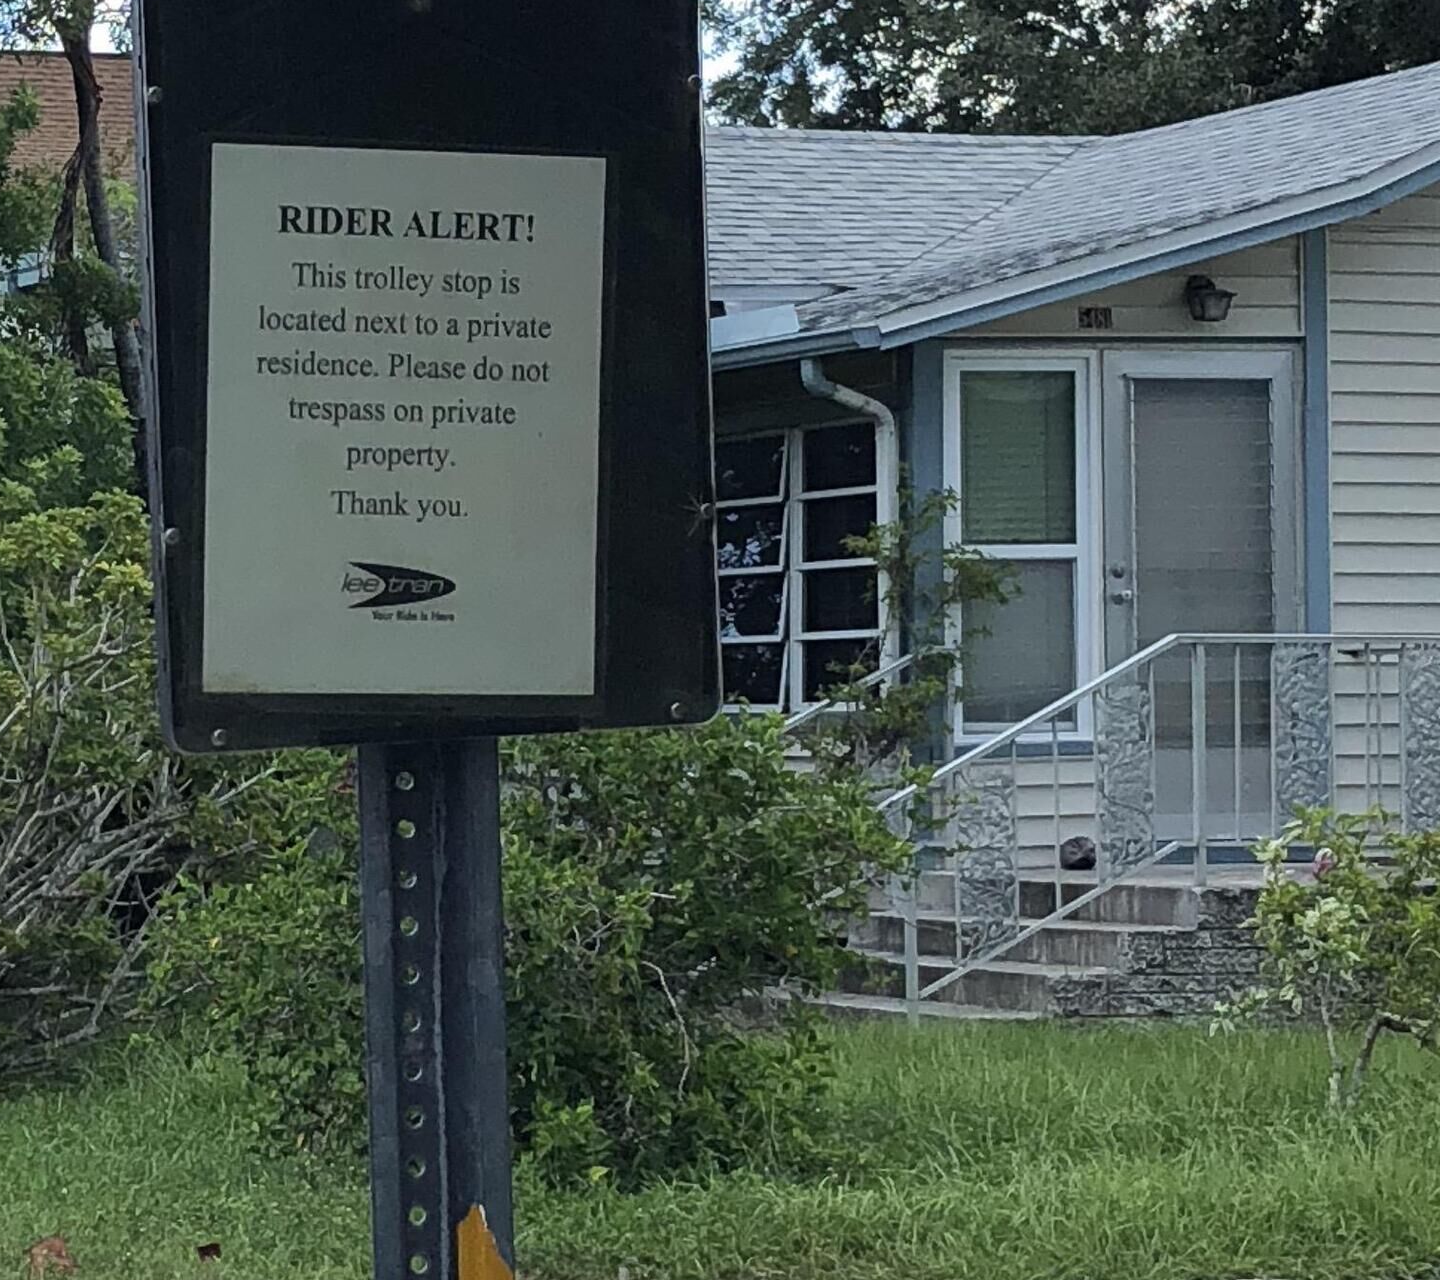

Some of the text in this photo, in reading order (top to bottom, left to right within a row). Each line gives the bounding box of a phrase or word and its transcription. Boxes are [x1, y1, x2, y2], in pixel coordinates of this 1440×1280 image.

[278, 205, 535, 242] RIDER ALERT!
[291, 262, 521, 299] This trolley stop is
[259, 305, 552, 343] located next to a private
[256, 350, 550, 382] residence. Please do not
[288, 398, 517, 429] trespass on private
[346, 445, 456, 471] property.
[331, 491, 469, 522] Thank you.
